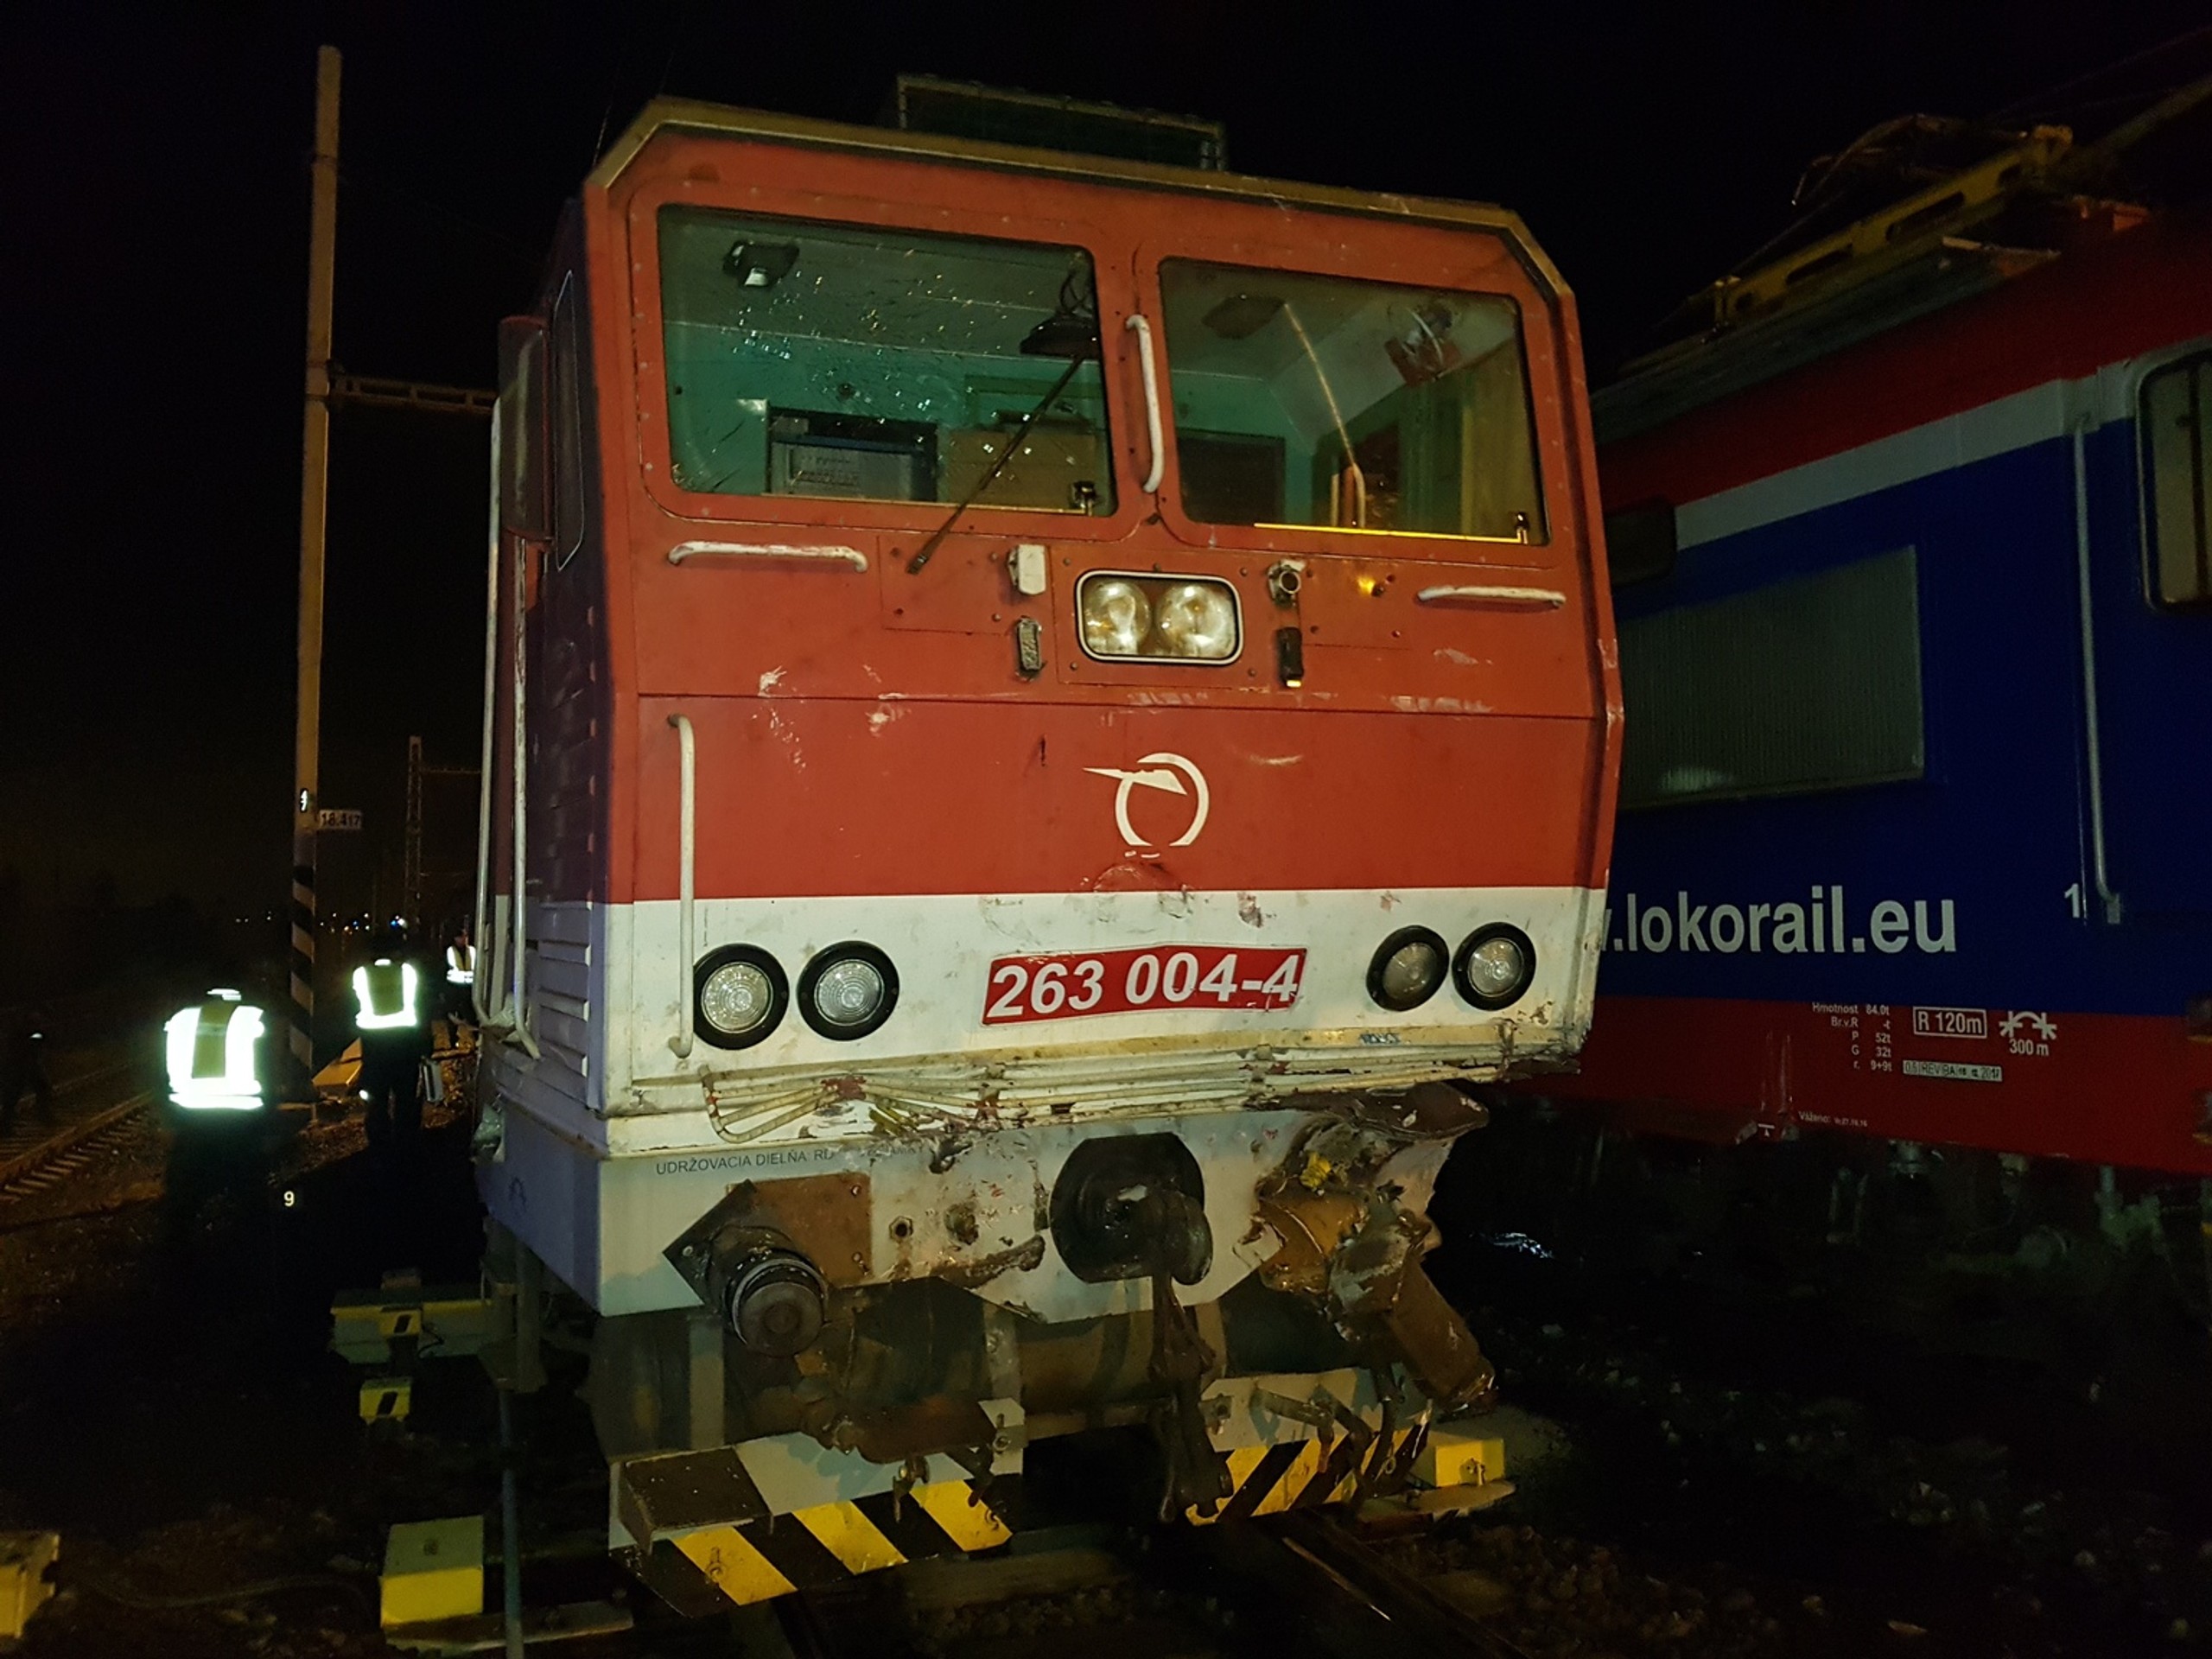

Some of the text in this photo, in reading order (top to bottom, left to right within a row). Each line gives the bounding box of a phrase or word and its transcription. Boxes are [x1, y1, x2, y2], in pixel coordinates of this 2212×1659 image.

[986, 951, 1299, 1018] 263 004-4
[1812, 1001, 1859, 1014] Hmotnost
[1917, 1010, 1982, 1034] R 120m
[1851, 1045, 1859, 1055] G
[2008, 1039, 2050, 1057] 300 m
[656, 1154, 752, 1175] UDRŽOVACIA
[755, 1149, 807, 1166] DIELŇA
